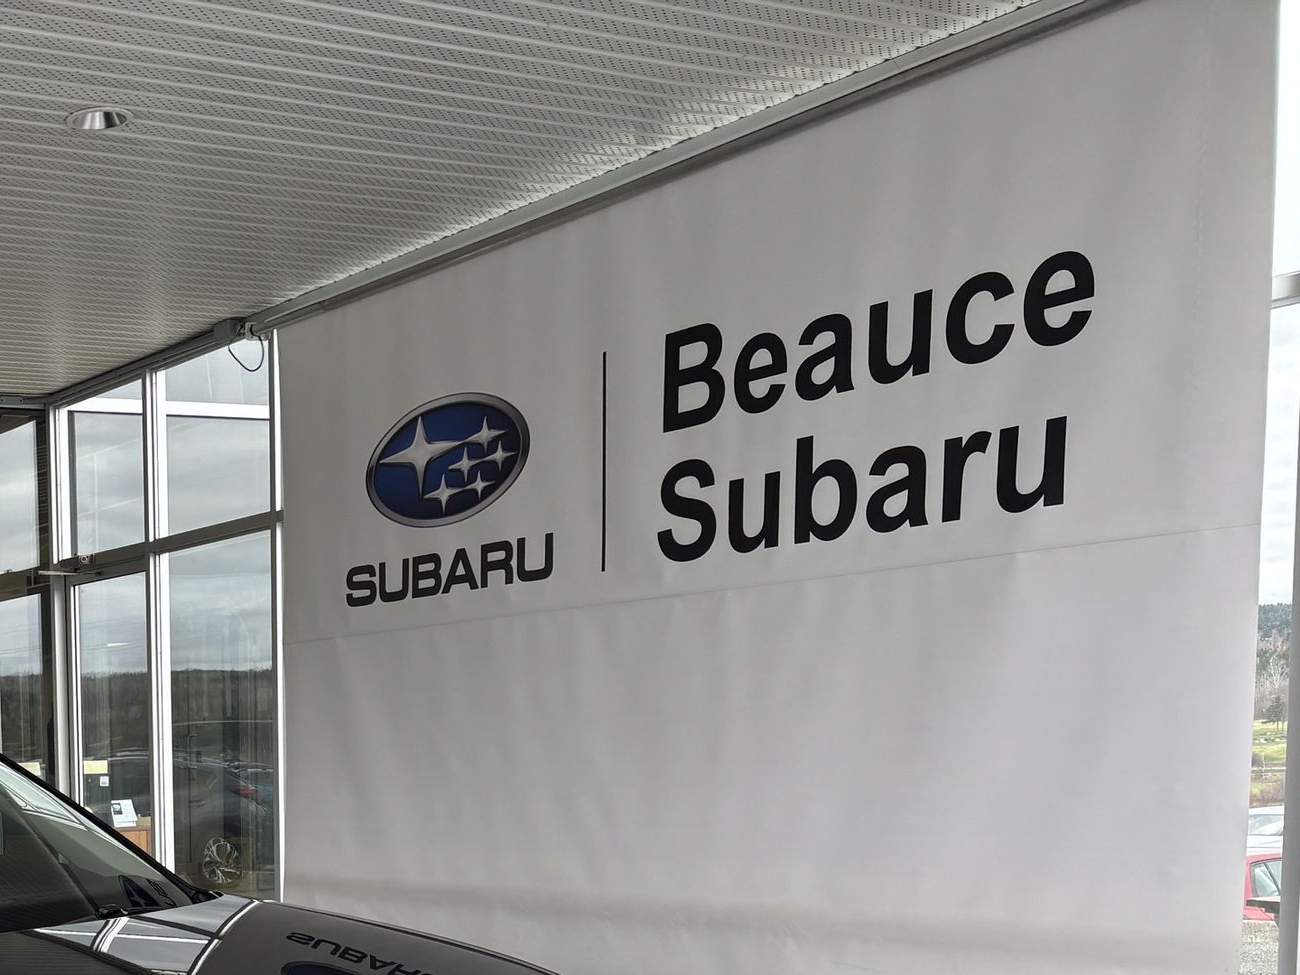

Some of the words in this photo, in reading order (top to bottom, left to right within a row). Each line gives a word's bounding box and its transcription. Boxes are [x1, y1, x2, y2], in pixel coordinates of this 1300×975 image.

[662, 250, 1096, 434] Beauce
[656, 415, 1068, 563] Subaru
[345, 532, 555, 608] SUBARU
